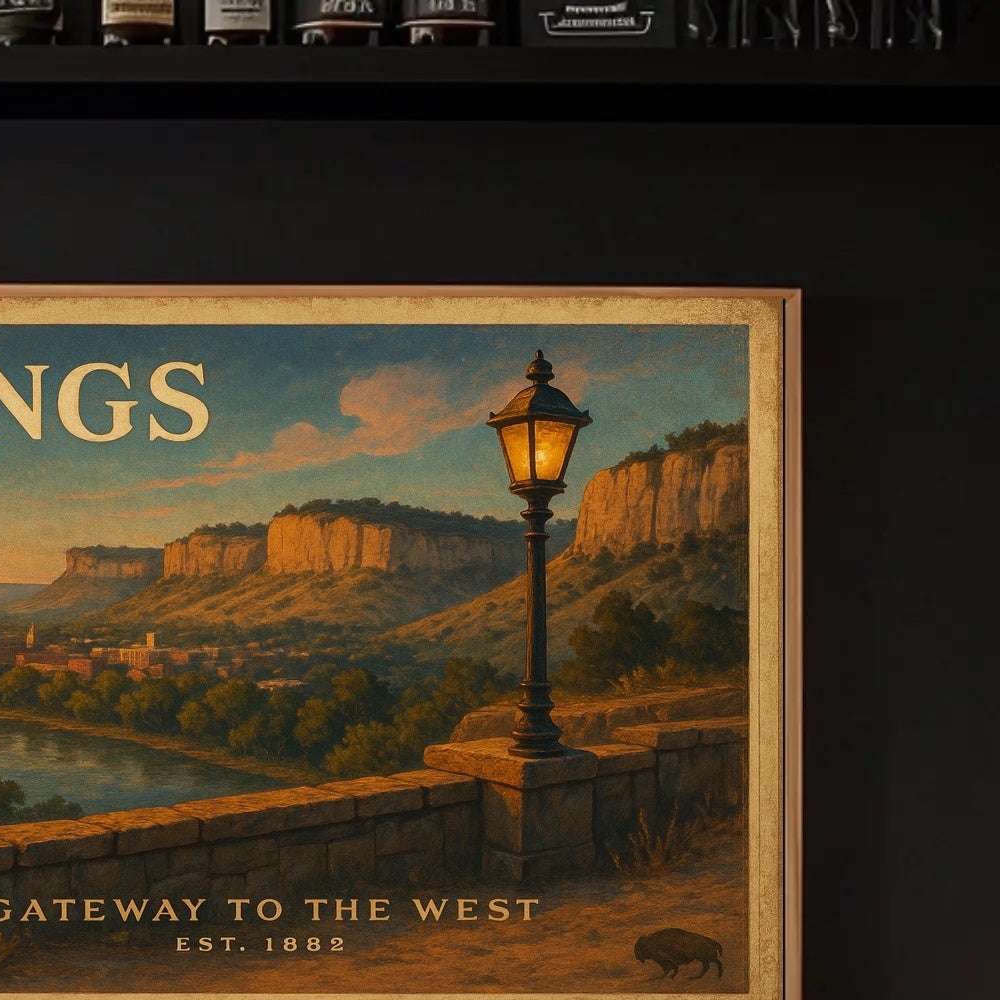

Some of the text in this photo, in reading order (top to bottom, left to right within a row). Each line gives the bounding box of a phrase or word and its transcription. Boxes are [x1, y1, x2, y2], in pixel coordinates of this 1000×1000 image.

[228, 899, 283, 923] TO
[305, 899, 391, 923] THE
[413, 899, 541, 923] WEST
[175, 937, 345, 953] EST. 1882
